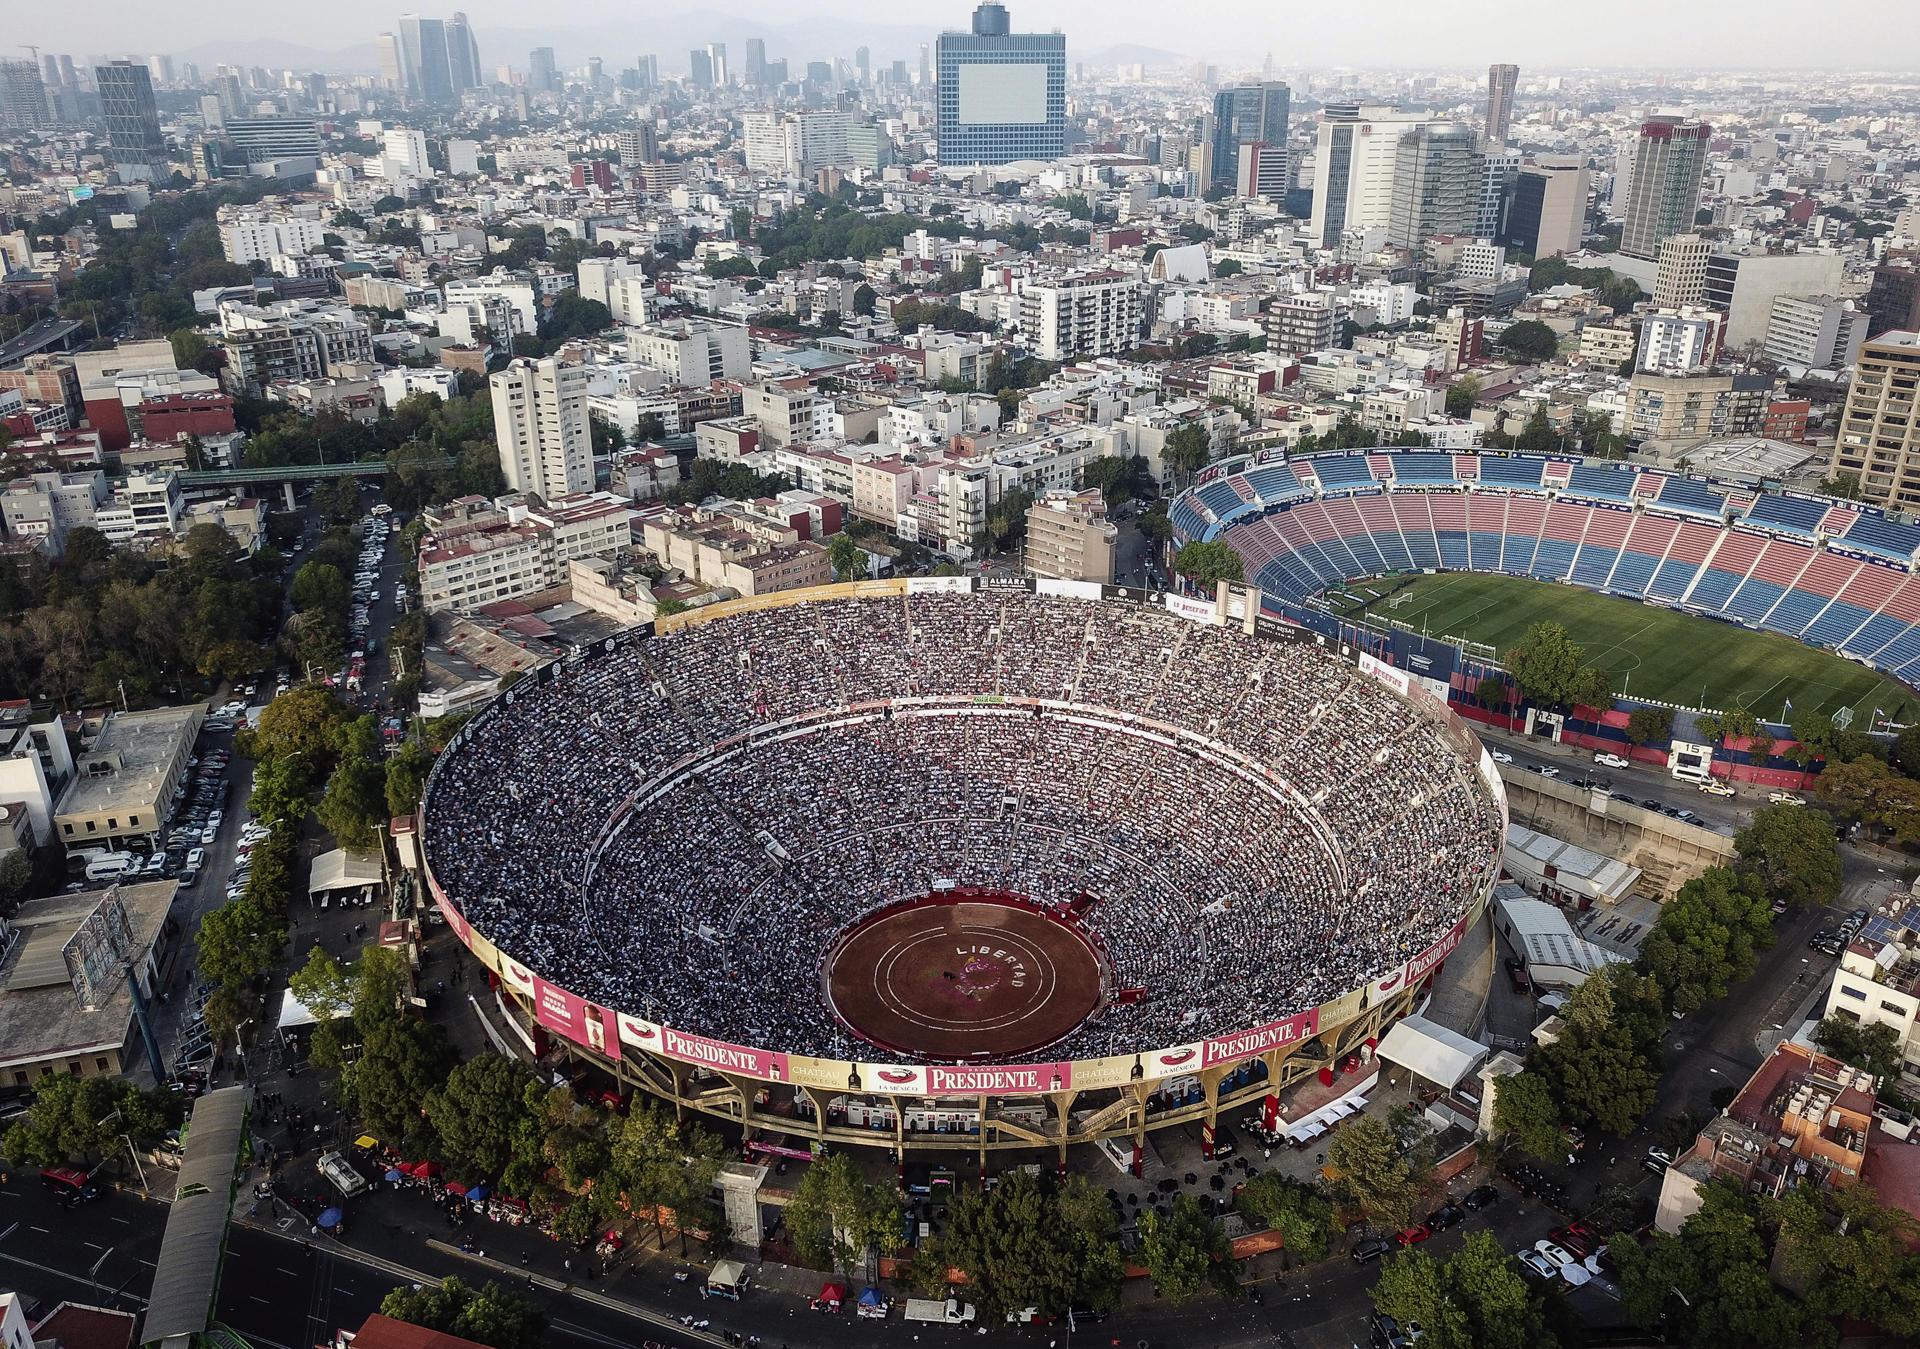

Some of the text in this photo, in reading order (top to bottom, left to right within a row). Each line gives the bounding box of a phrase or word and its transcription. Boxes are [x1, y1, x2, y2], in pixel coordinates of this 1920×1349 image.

[1258, 619, 1276, 630] GRUPO
[1276, 625, 1296, 635] BRISAS
[1684, 743, 1700, 753] 15
[956, 945, 1027, 988] LIBERTAD
[1408, 932, 1455, 981] PRESIDENTE
[1320, 1003, 1352, 1022] CHATEAU
[665, 1030, 758, 1072] PRESIDENTE
[1206, 1022, 1294, 1062] PRESIDENTE
[792, 1066, 840, 1079] CHATEAU
[931, 1068, 1038, 1090] PRESIDENTE
[1074, 1067, 1123, 1079] CHATEAU
